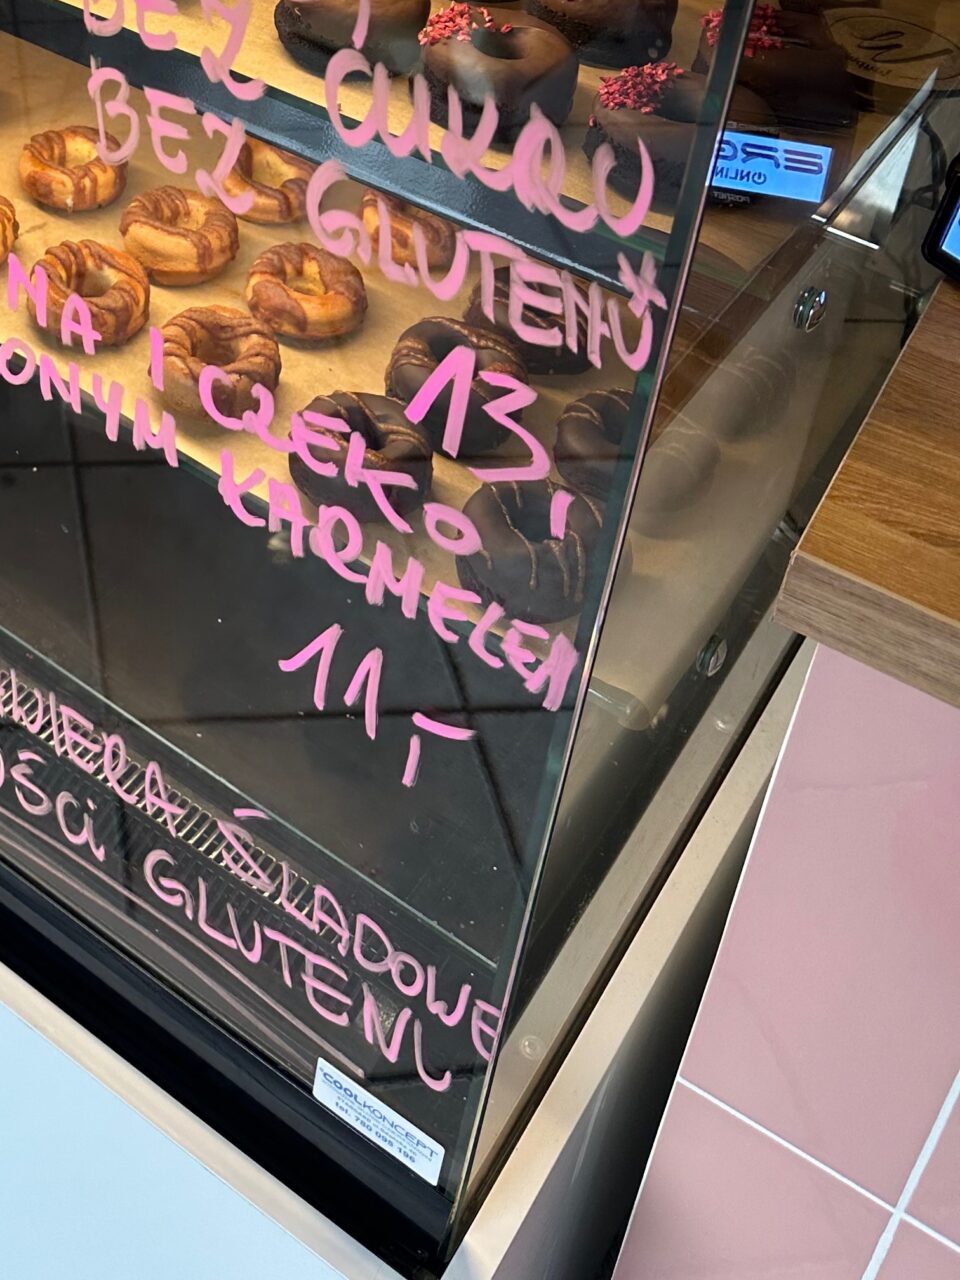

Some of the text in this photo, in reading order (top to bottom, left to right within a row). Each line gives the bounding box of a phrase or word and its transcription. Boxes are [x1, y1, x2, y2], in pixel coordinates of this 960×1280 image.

[87, 56, 256, 215] BEZ
[324, 47, 655, 238] CUKRU
[143, 848, 453, 1093] GLUTENU
